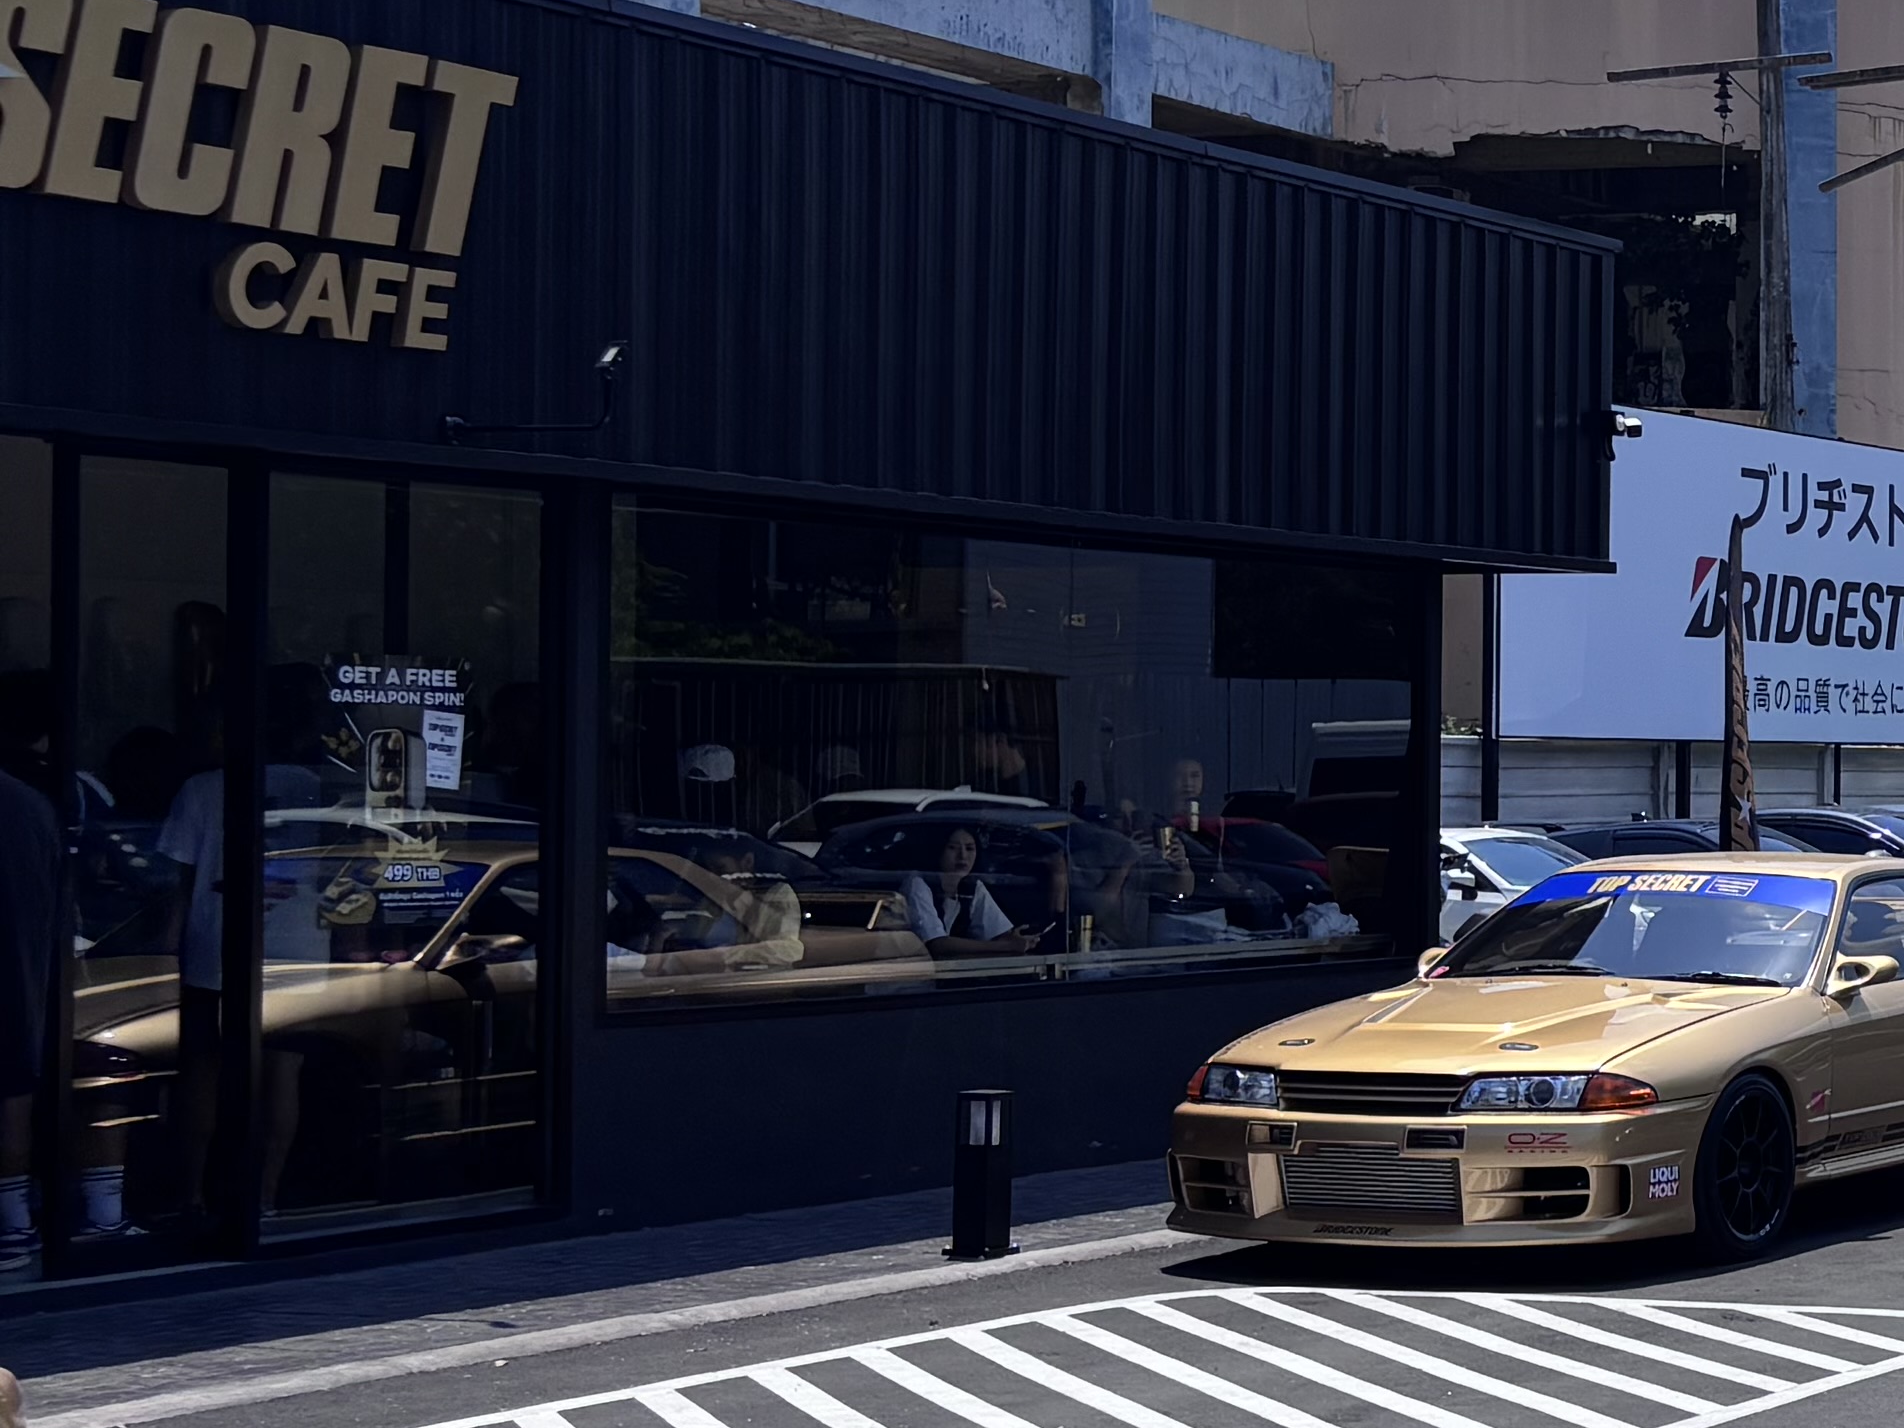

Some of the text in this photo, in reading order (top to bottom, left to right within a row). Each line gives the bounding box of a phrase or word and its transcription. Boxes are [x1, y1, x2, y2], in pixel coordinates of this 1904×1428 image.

[217, 241, 456, 351] CAFE
[338, 665, 457, 688] GET A FREE
[330, 689, 464, 707] GASHAPON SPIN!
[383, 863, 413, 882] 499
[1587, 875, 1632, 893] TOP
[1628, 873, 1712, 893] SECRET
[1650, 1165, 1679, 1183] LIQUI
[1648, 1181, 1680, 1199] MOLY
